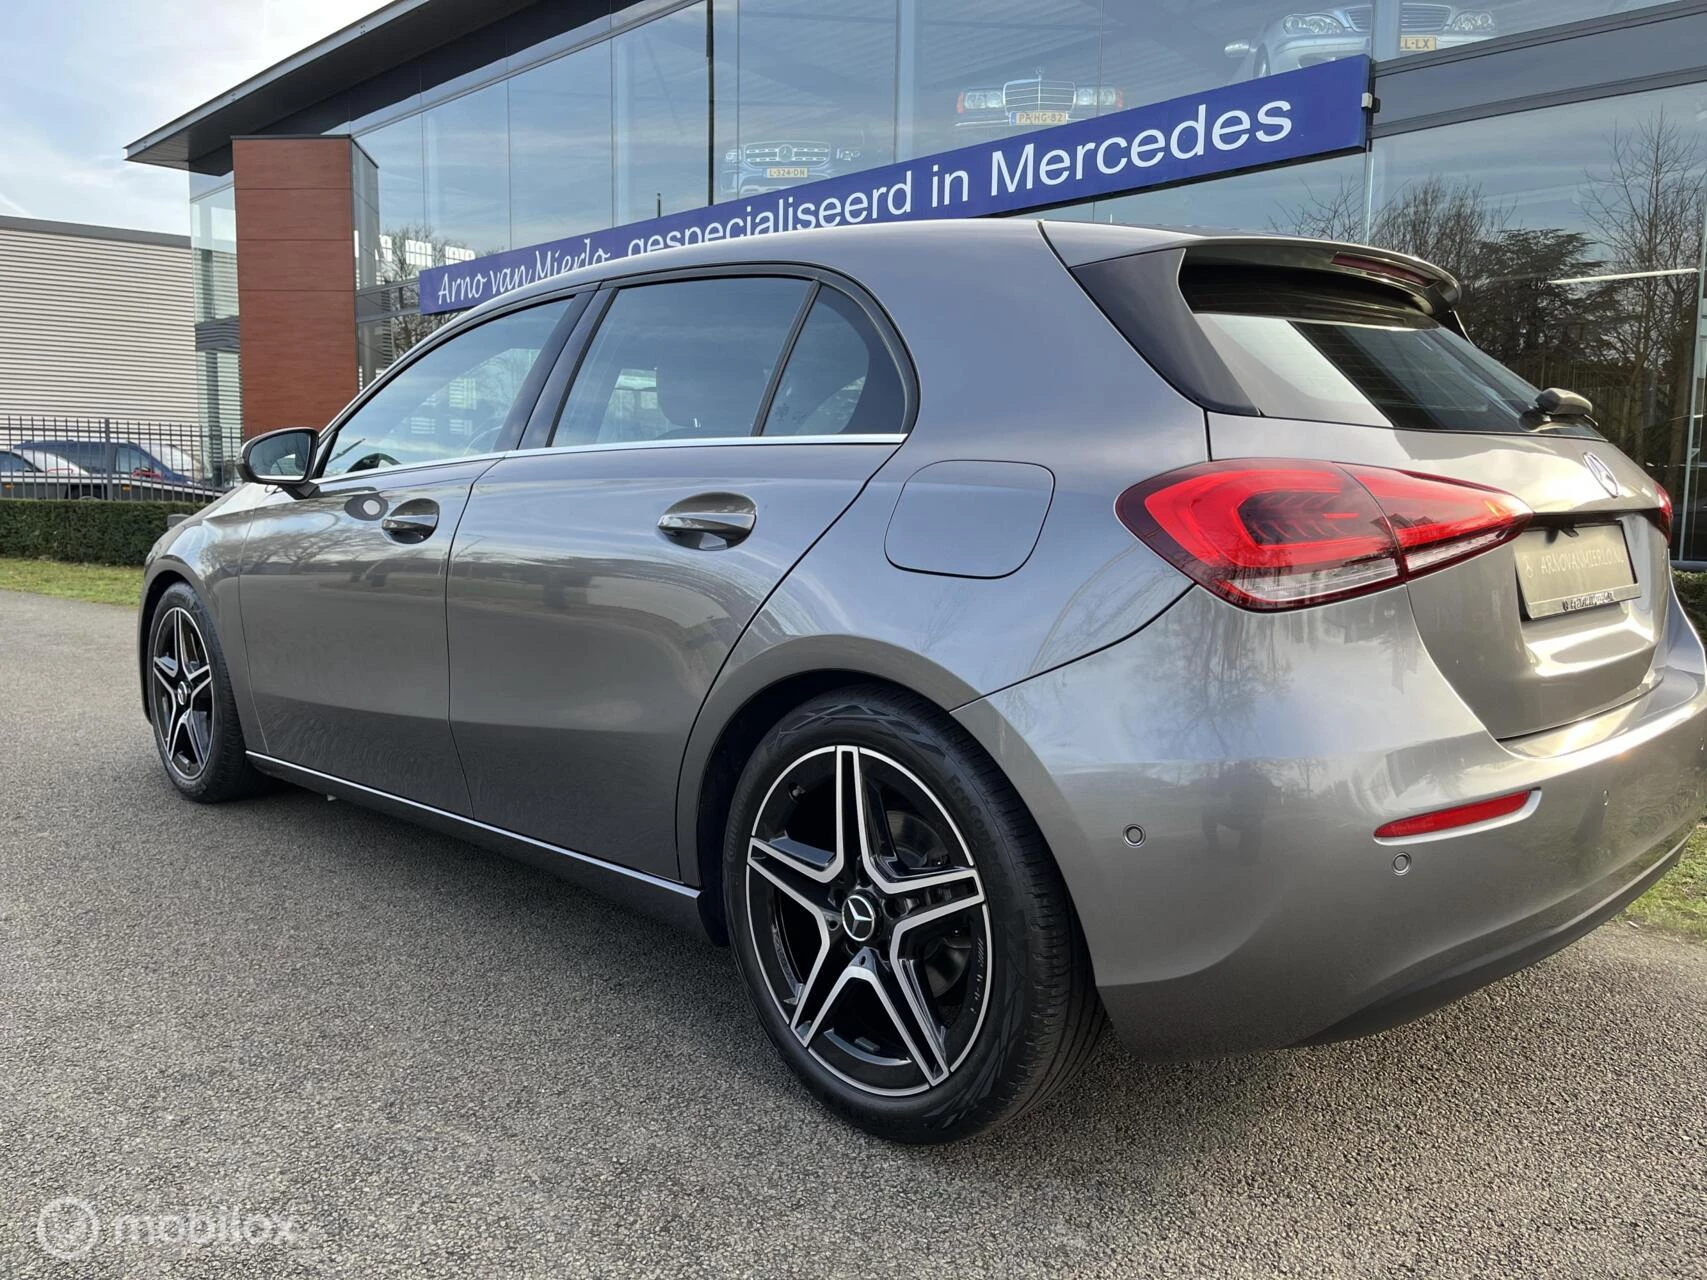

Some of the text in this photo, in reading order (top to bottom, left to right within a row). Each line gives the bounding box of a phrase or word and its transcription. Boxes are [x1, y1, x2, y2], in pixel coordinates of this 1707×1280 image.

[438, 273, 487, 304] Arno
[489, 264, 533, 294] van
[931, 164, 969, 208] in
[990, 100, 1292, 197] Mercedes
